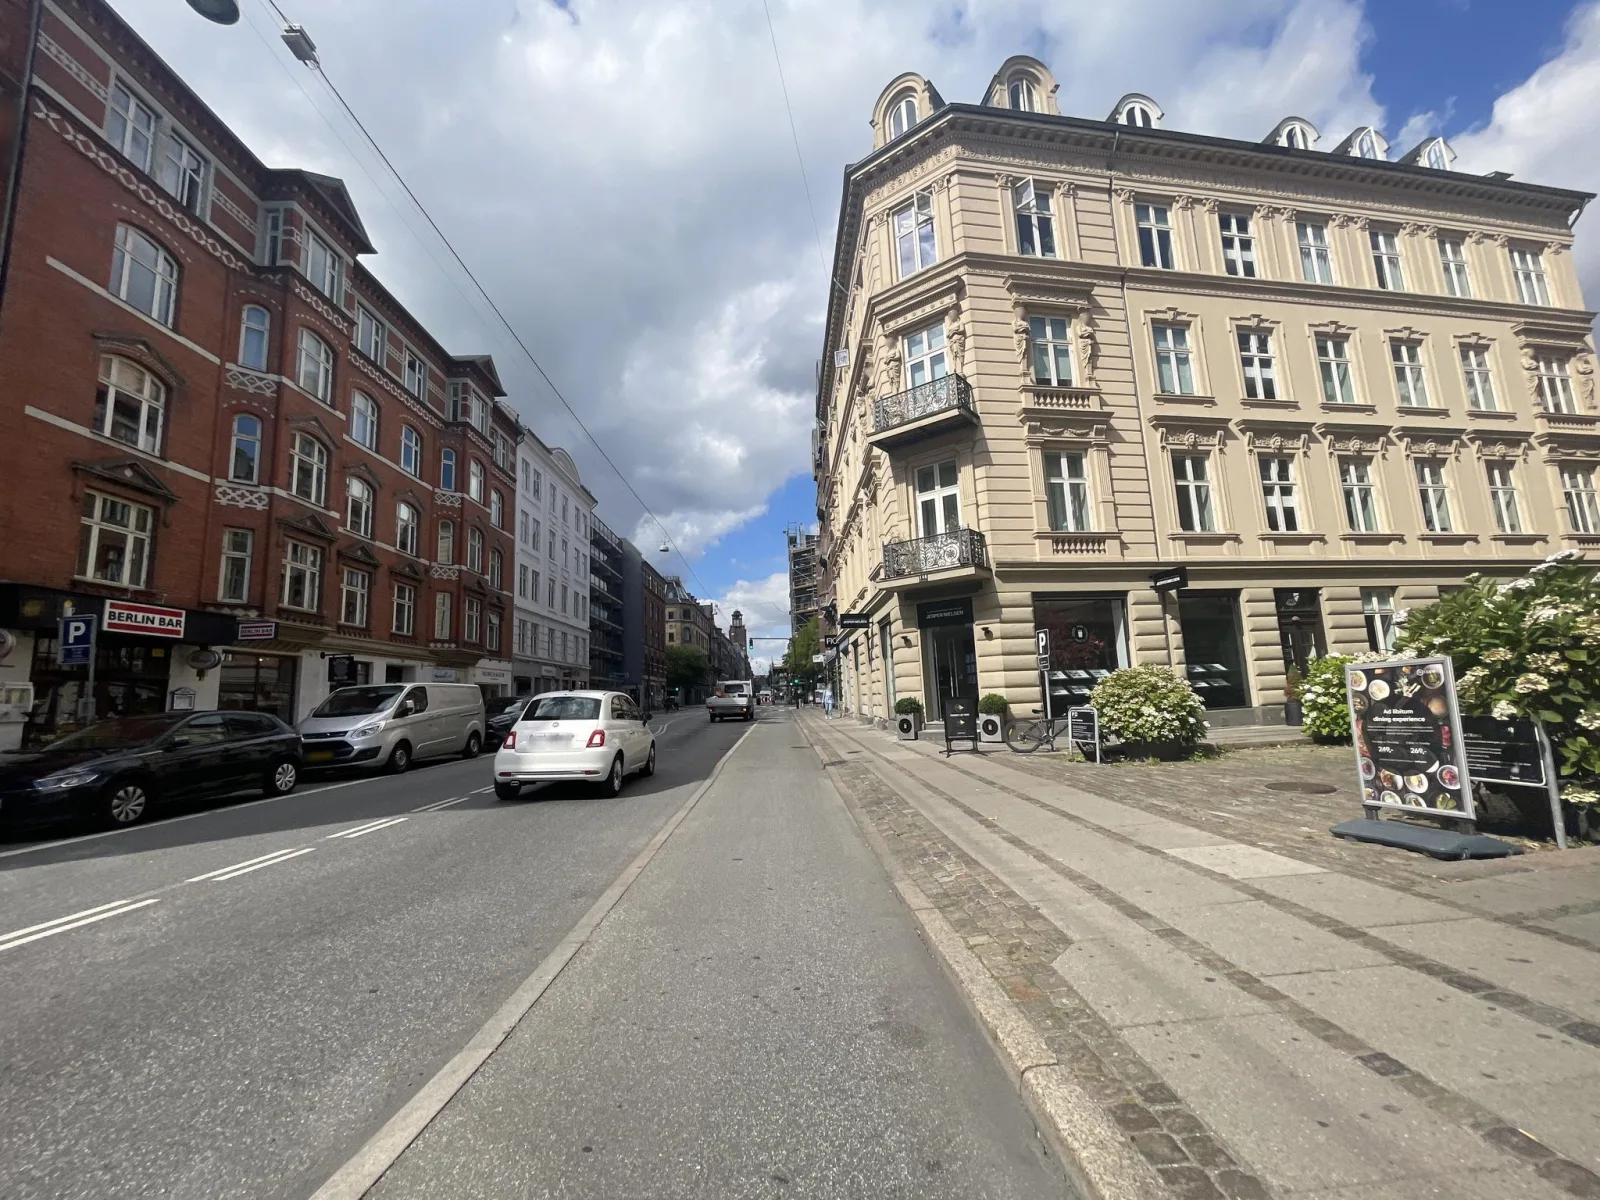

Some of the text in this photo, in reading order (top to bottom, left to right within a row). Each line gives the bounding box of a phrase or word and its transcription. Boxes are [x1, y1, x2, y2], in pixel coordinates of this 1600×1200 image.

[108, 611, 182, 628] BERLIN BAR
[68, 622, 86, 643] P
[1039, 633, 1046, 653] P
